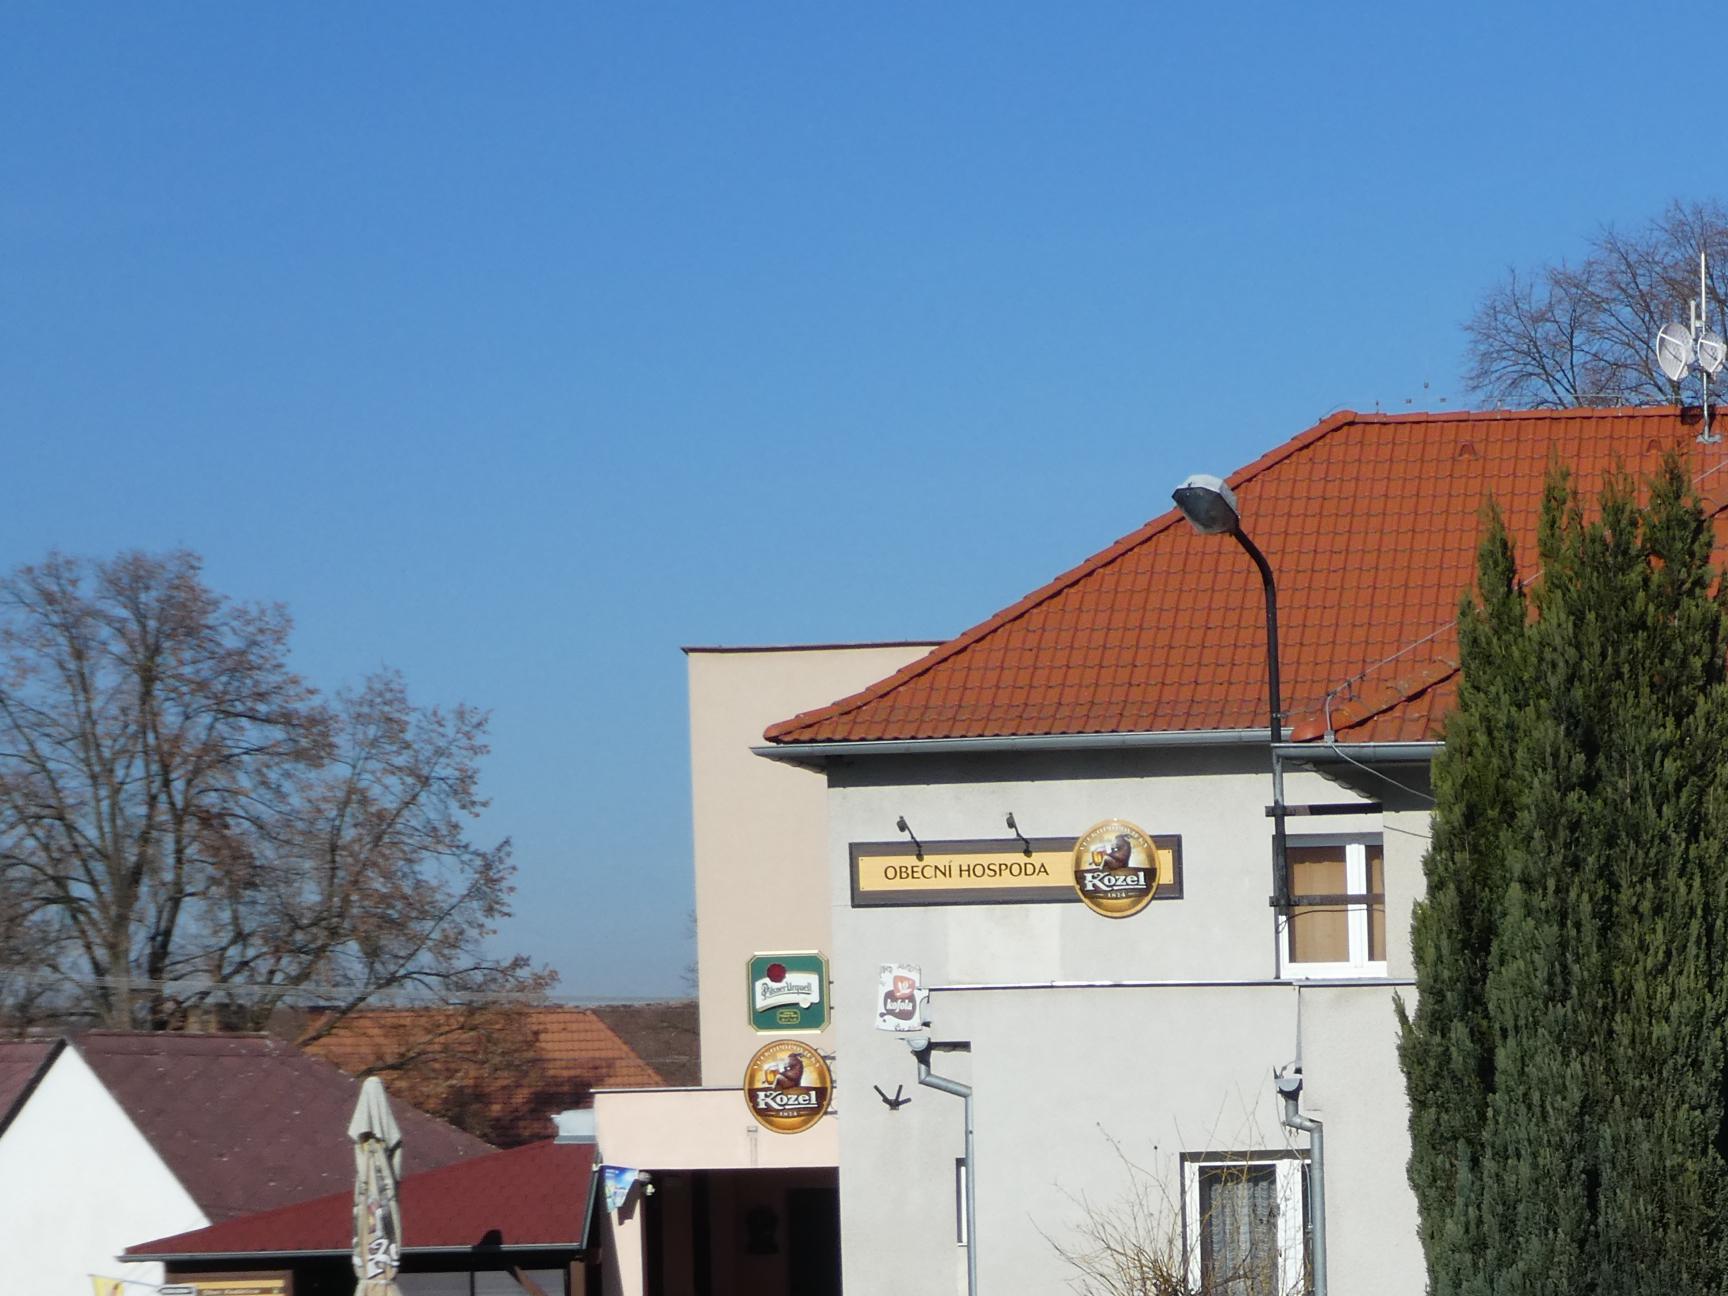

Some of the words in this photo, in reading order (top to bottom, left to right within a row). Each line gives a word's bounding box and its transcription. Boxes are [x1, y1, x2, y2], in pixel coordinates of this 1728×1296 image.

[884, 860, 952, 880] OBECNÍ
[959, 862, 1050, 878] HOSPODA
[1083, 871, 1147, 891] Kozel
[756, 1090, 819, 1110] Kozel
